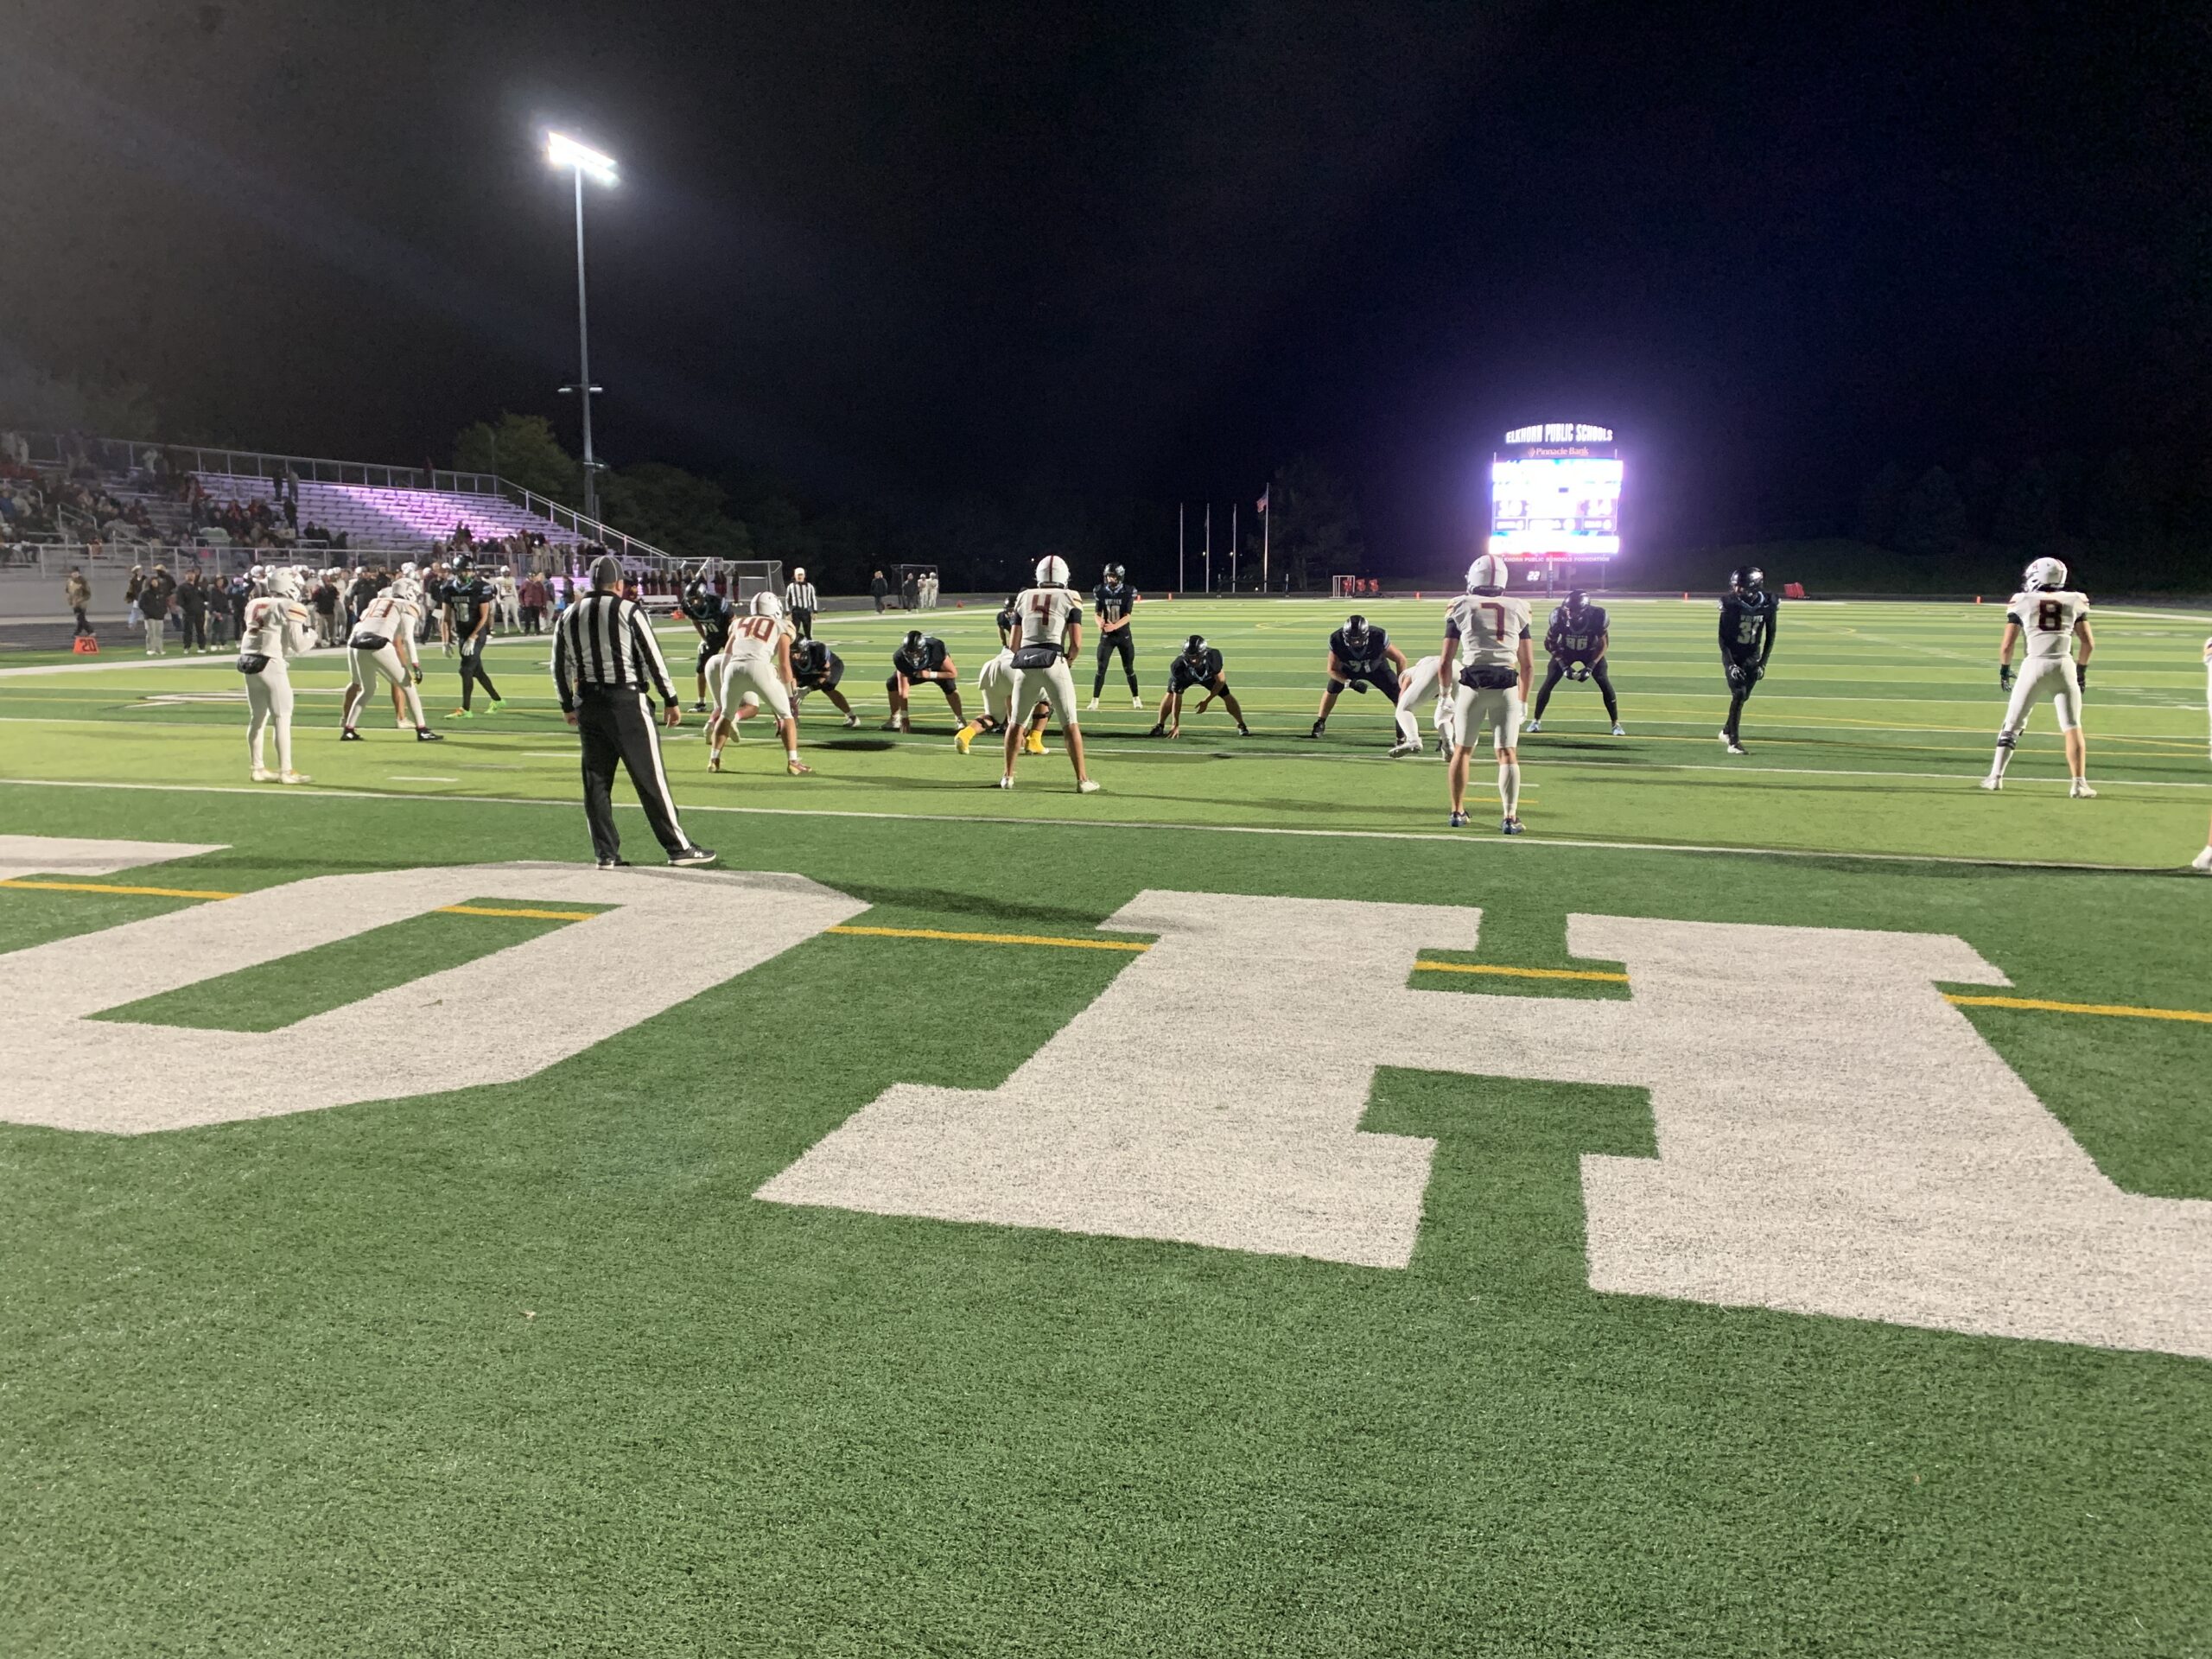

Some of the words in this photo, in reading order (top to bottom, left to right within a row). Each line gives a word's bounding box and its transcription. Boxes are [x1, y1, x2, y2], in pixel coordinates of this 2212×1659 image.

[1506, 424, 1543, 443] ELKHORN
[1545, 423, 1574, 442] PUBLIC
[1575, 423, 1613, 442] SCHOOLS
[1569, 447, 1589, 456] Bank
[1527, 571, 1540, 581] 22
[1033, 594, 1052, 626] 4
[1106, 605, 1121, 624] 10
[2039, 600, 2063, 631] 8
[737, 617, 776, 642] 40
[1480, 602, 1505, 641] 7
[79, 639, 98, 652] 20
